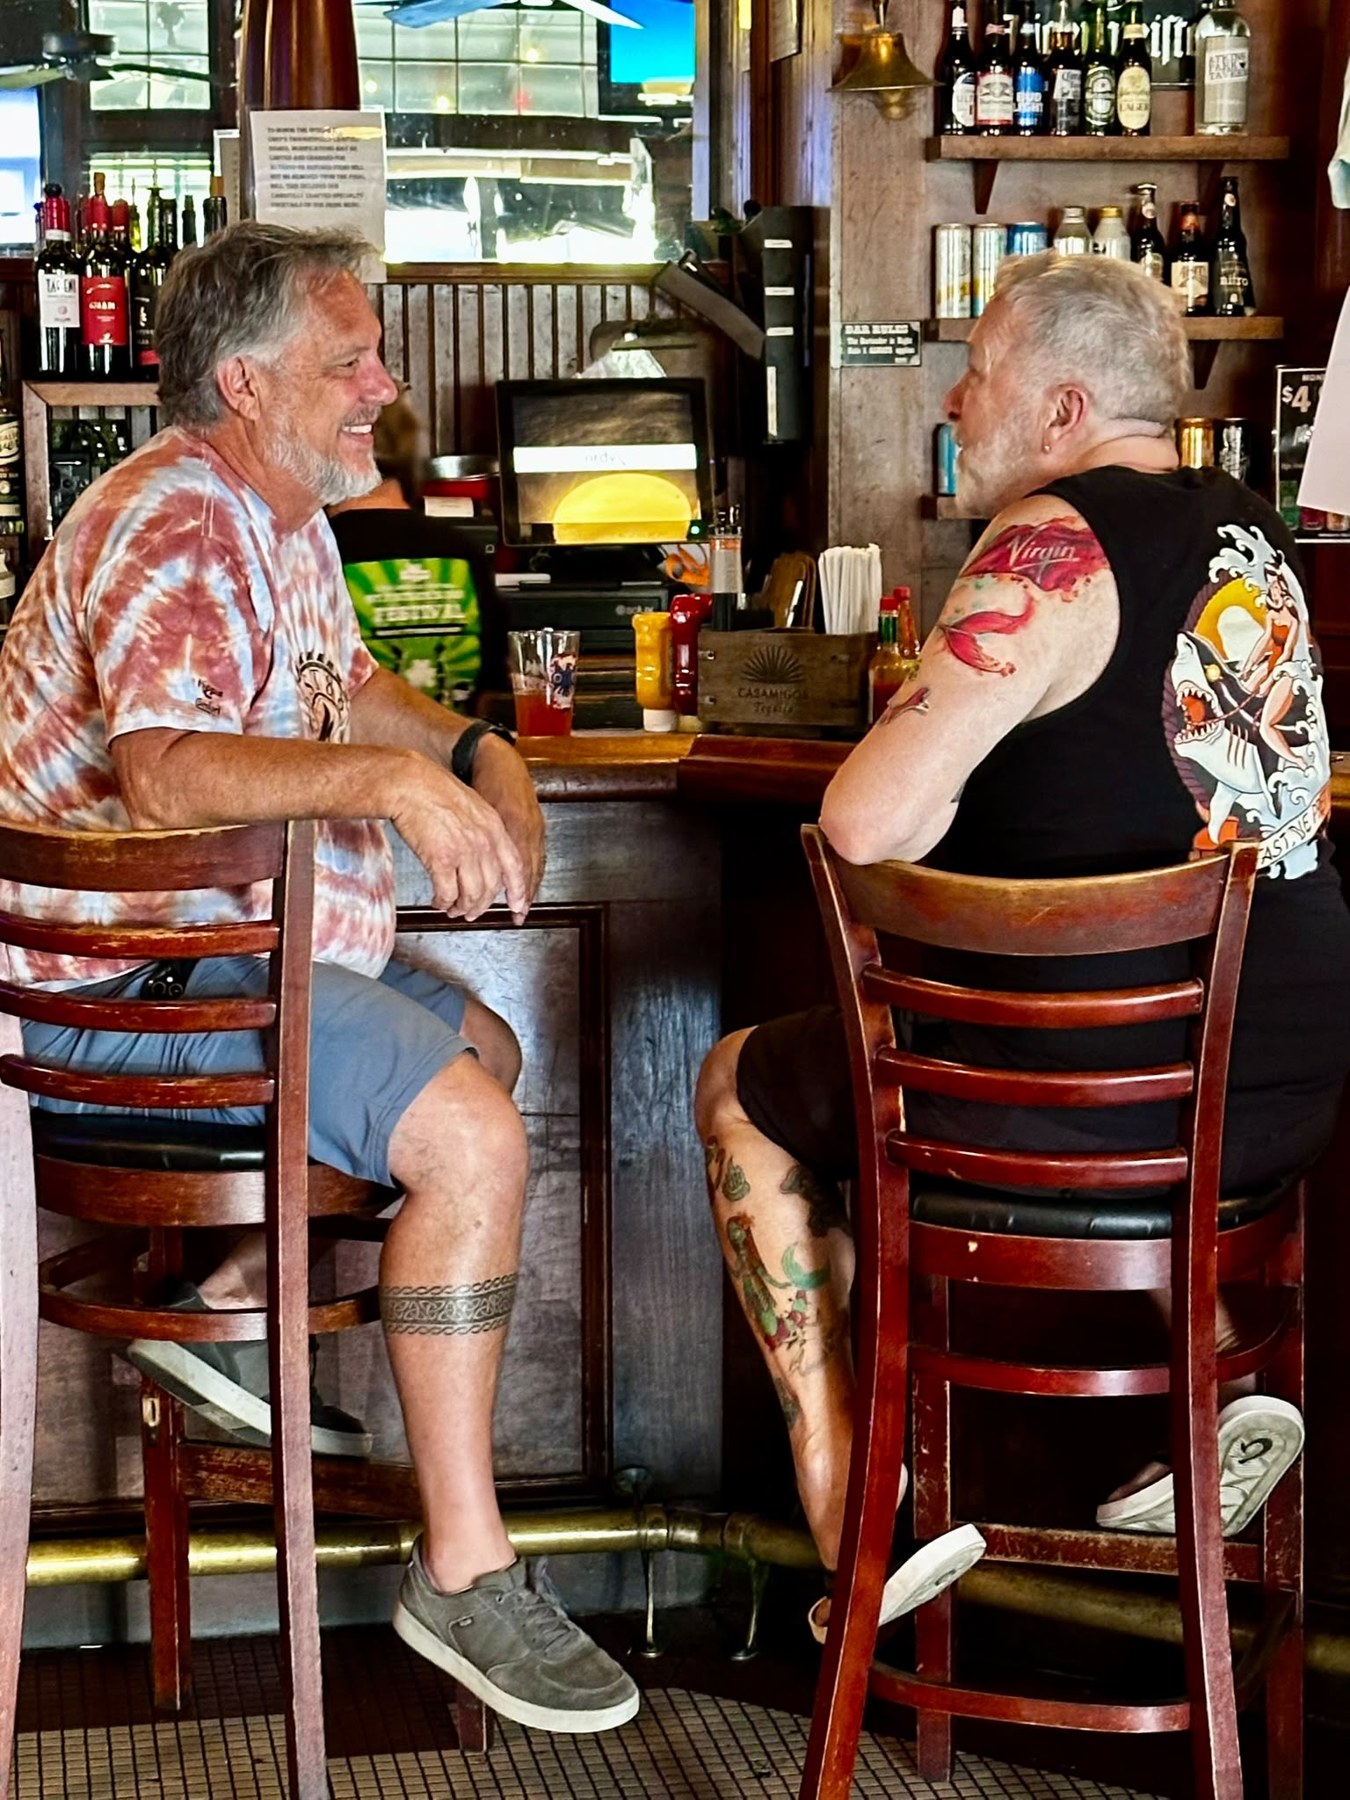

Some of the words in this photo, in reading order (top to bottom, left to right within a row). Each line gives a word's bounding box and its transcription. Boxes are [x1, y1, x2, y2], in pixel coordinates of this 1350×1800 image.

[1016, 92, 1042, 102] BUD
[1219, 272, 1249, 286] nitro
[845, 324, 871, 335] BAR
[1281, 384, 1312, 413] $4
[1006, 523, 1080, 585] Virgin
[737, 687, 809, 700] CASAMIGOS
